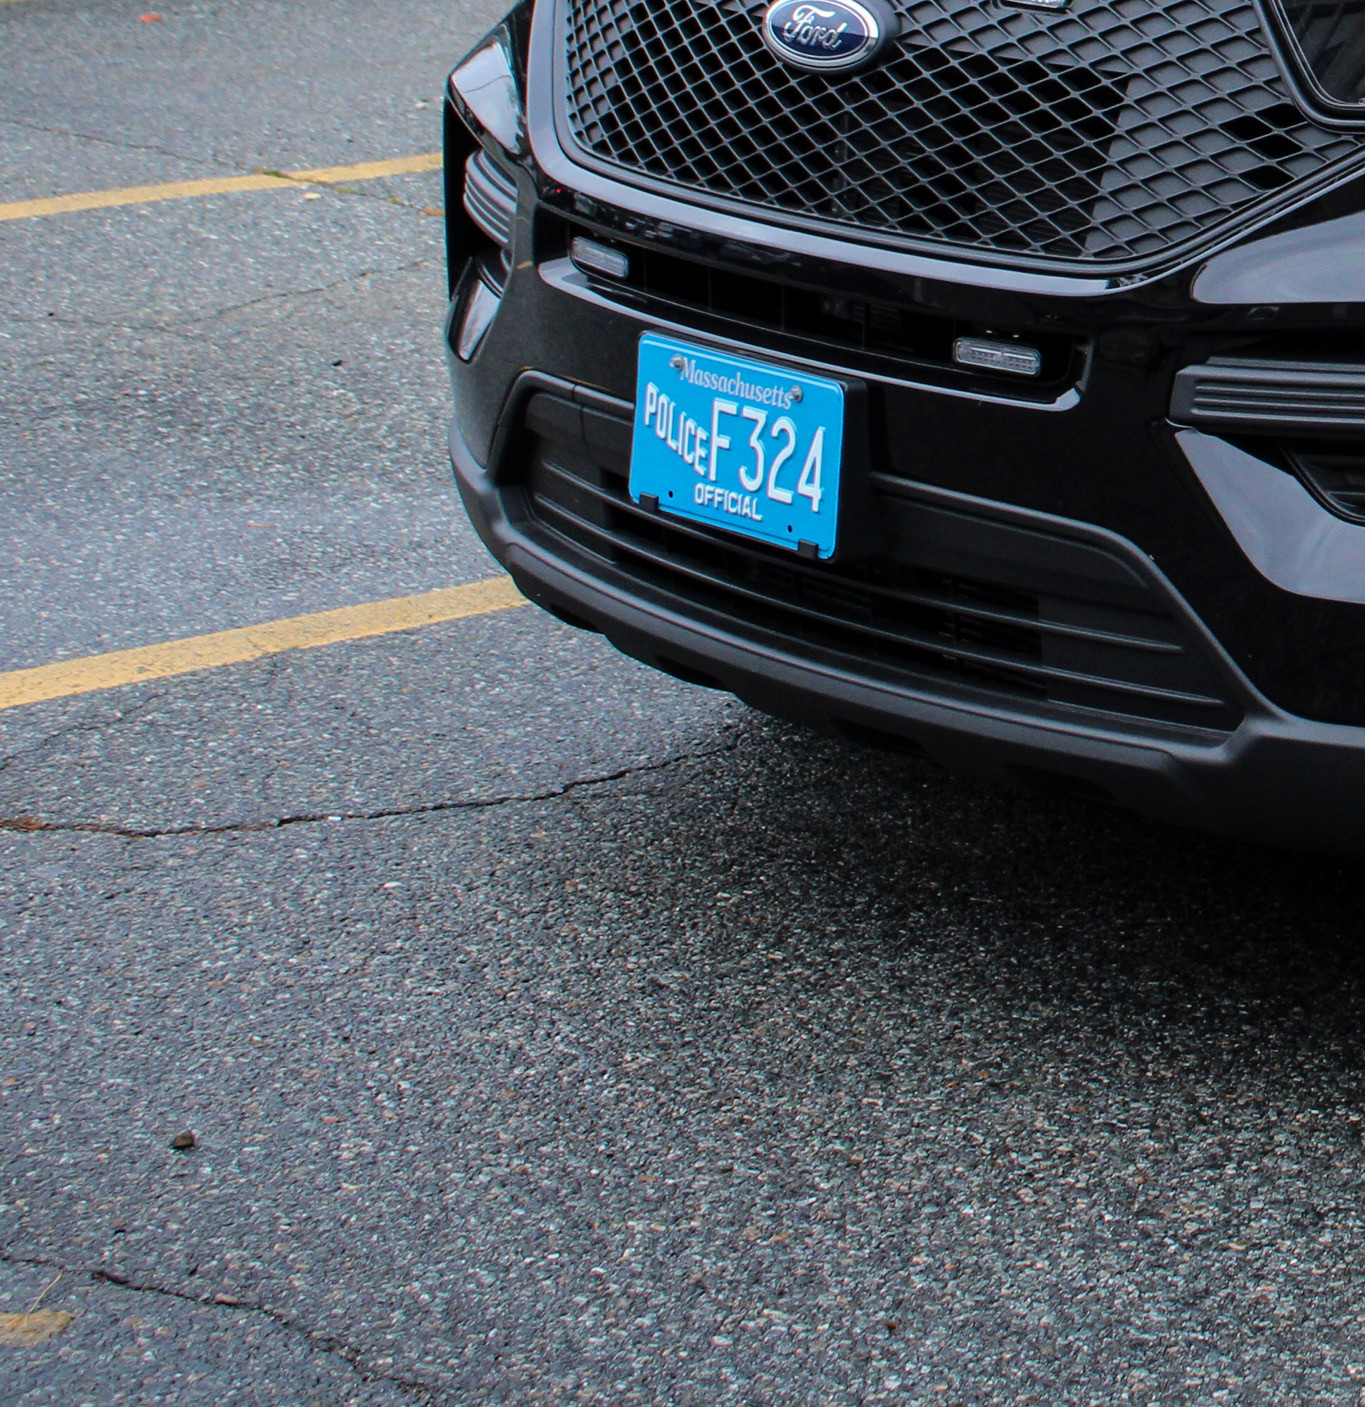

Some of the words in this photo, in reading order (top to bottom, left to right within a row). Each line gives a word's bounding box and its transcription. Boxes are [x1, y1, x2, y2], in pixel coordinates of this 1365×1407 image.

[782, 4, 848, 51] Ford
[680, 356, 794, 410] Massachusetts
[643, 381, 710, 477] POLICE
[708, 397, 827, 514] F324
[694, 482, 764, 522] OFFICIAL
